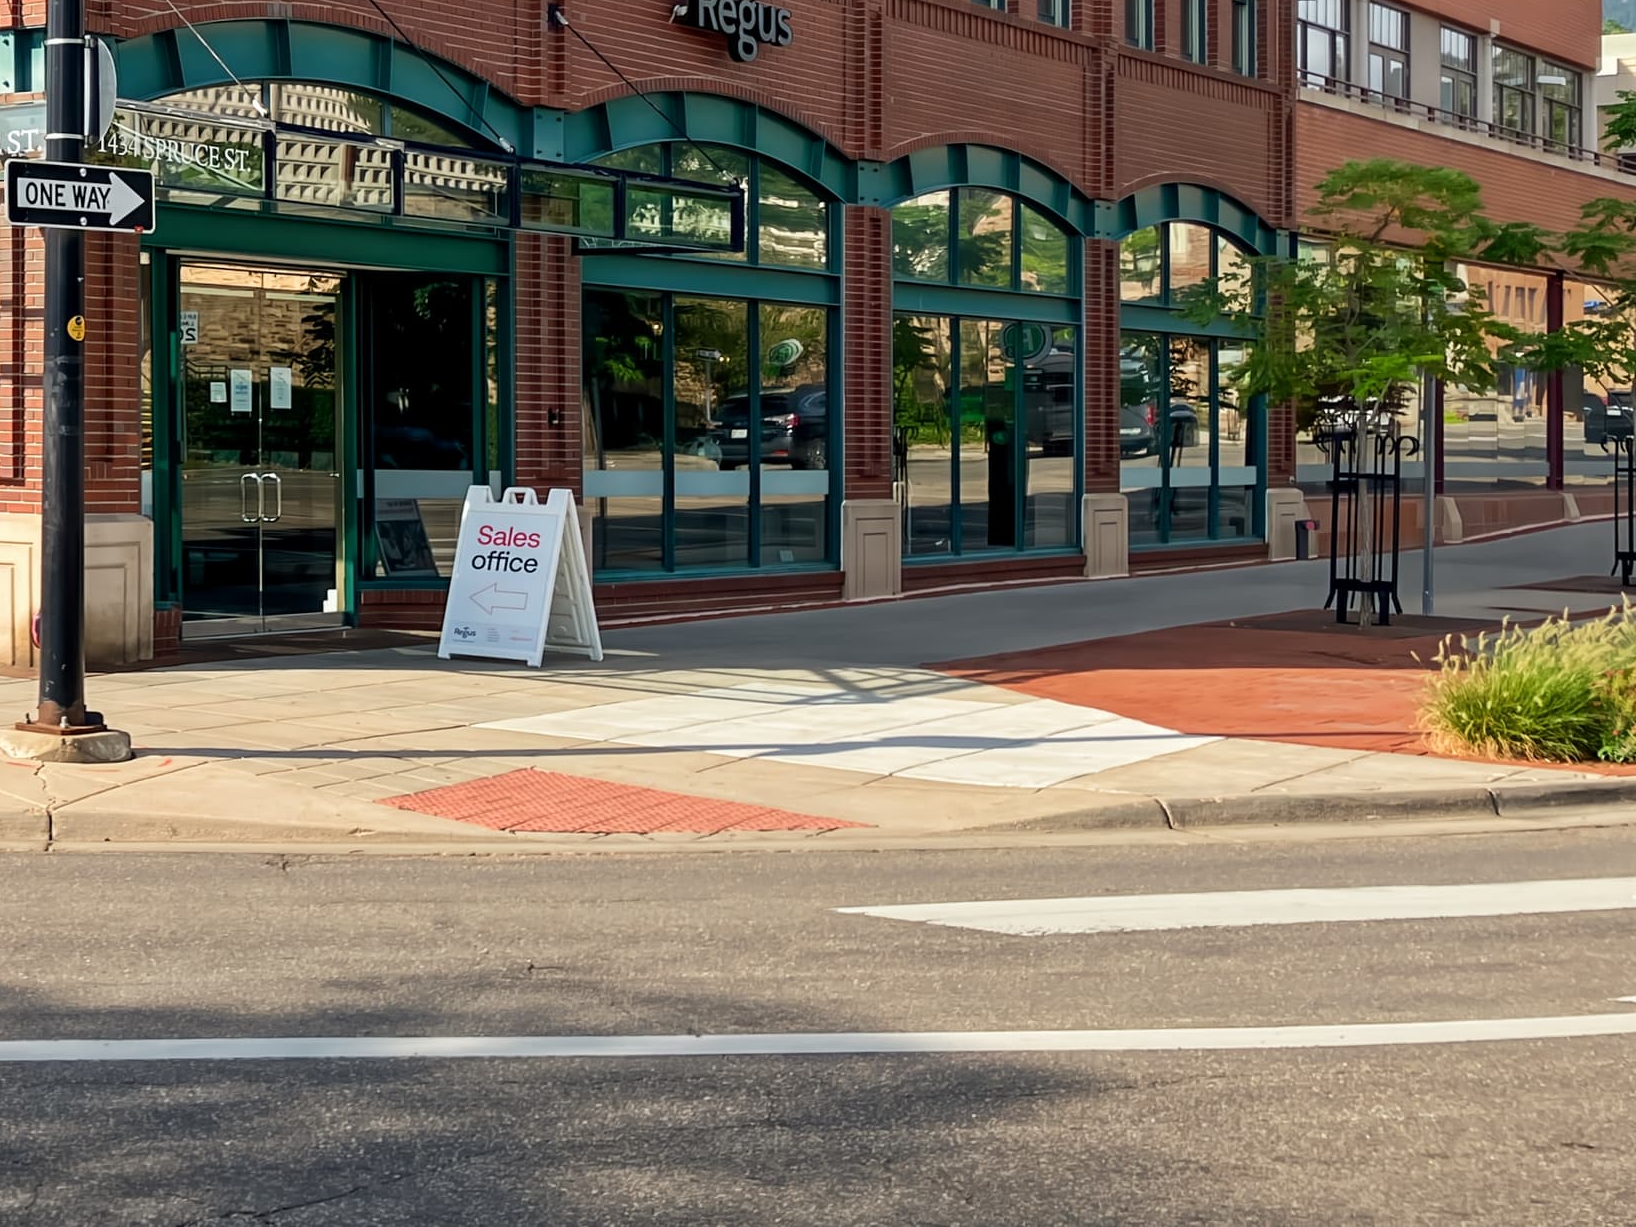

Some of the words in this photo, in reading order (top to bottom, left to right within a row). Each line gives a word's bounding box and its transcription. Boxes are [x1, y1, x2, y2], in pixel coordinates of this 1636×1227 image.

[6, 128, 44, 154] ST.
[97, 132, 140, 158] 1434
[143, 136, 222, 173] SPRUCE
[224, 147, 252, 173] ST.
[25, 181, 66, 207] ONE
[72, 184, 112, 210] WAY
[476, 524, 542, 549] Sales
[471, 550, 539, 574] office
